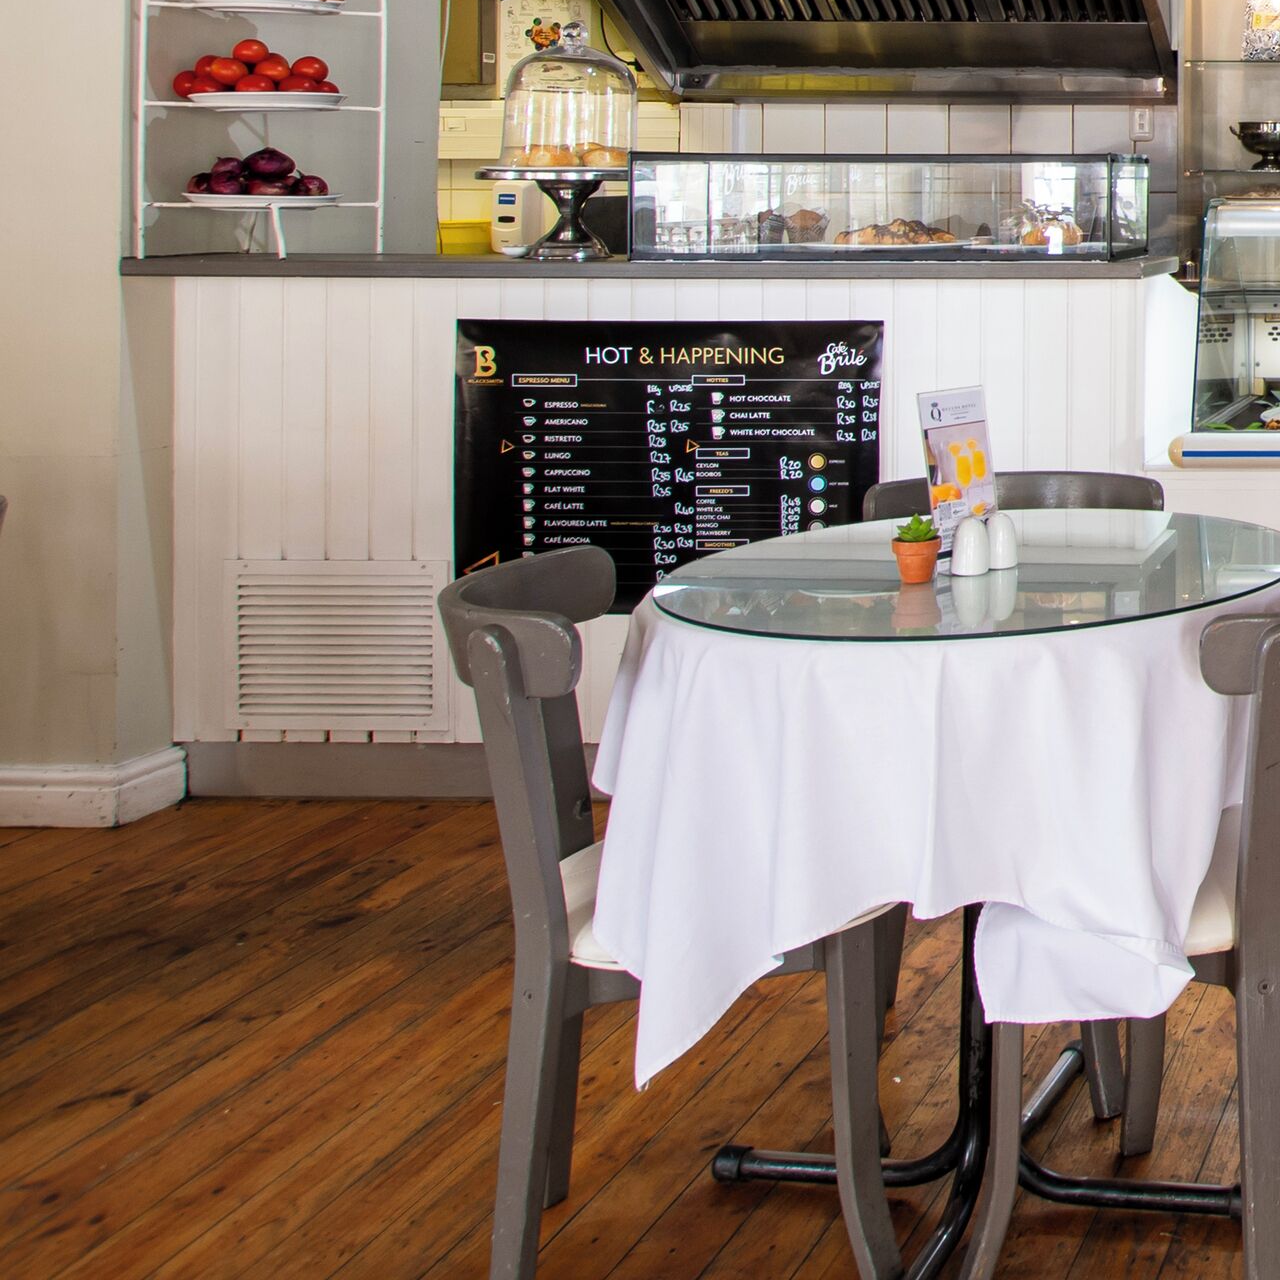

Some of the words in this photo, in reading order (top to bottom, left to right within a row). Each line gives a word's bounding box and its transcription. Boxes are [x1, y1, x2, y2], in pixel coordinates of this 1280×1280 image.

[585, 347, 633, 364] HOT
[639, 347, 654, 365] &
[660, 347, 785, 365] HAPPENING
[817, 349, 868, 375] Brûlé
[670, 400, 691, 412] R25
[837, 395, 855, 409] R30
[862, 395, 879, 407] R35
[544, 418, 588, 426] AMERICANO
[837, 412, 856, 425] R35
[647, 420, 667, 433] R25
[671, 420, 690, 433] R35
[836, 430, 856, 442] R32
[650, 451, 671, 464] R27
[780, 456, 801, 469] R20
[652, 468, 671, 482] R35
[675, 468, 695, 482] R45
[781, 469, 803, 479] R20
[652, 483, 672, 497] R35
[781, 494, 801, 506] R48
[675, 502, 694, 515] R40
[653, 524, 672, 533] R30
[674, 523, 693, 533] R38
[654, 536, 675, 550] R30
[655, 552, 677, 565] R30
